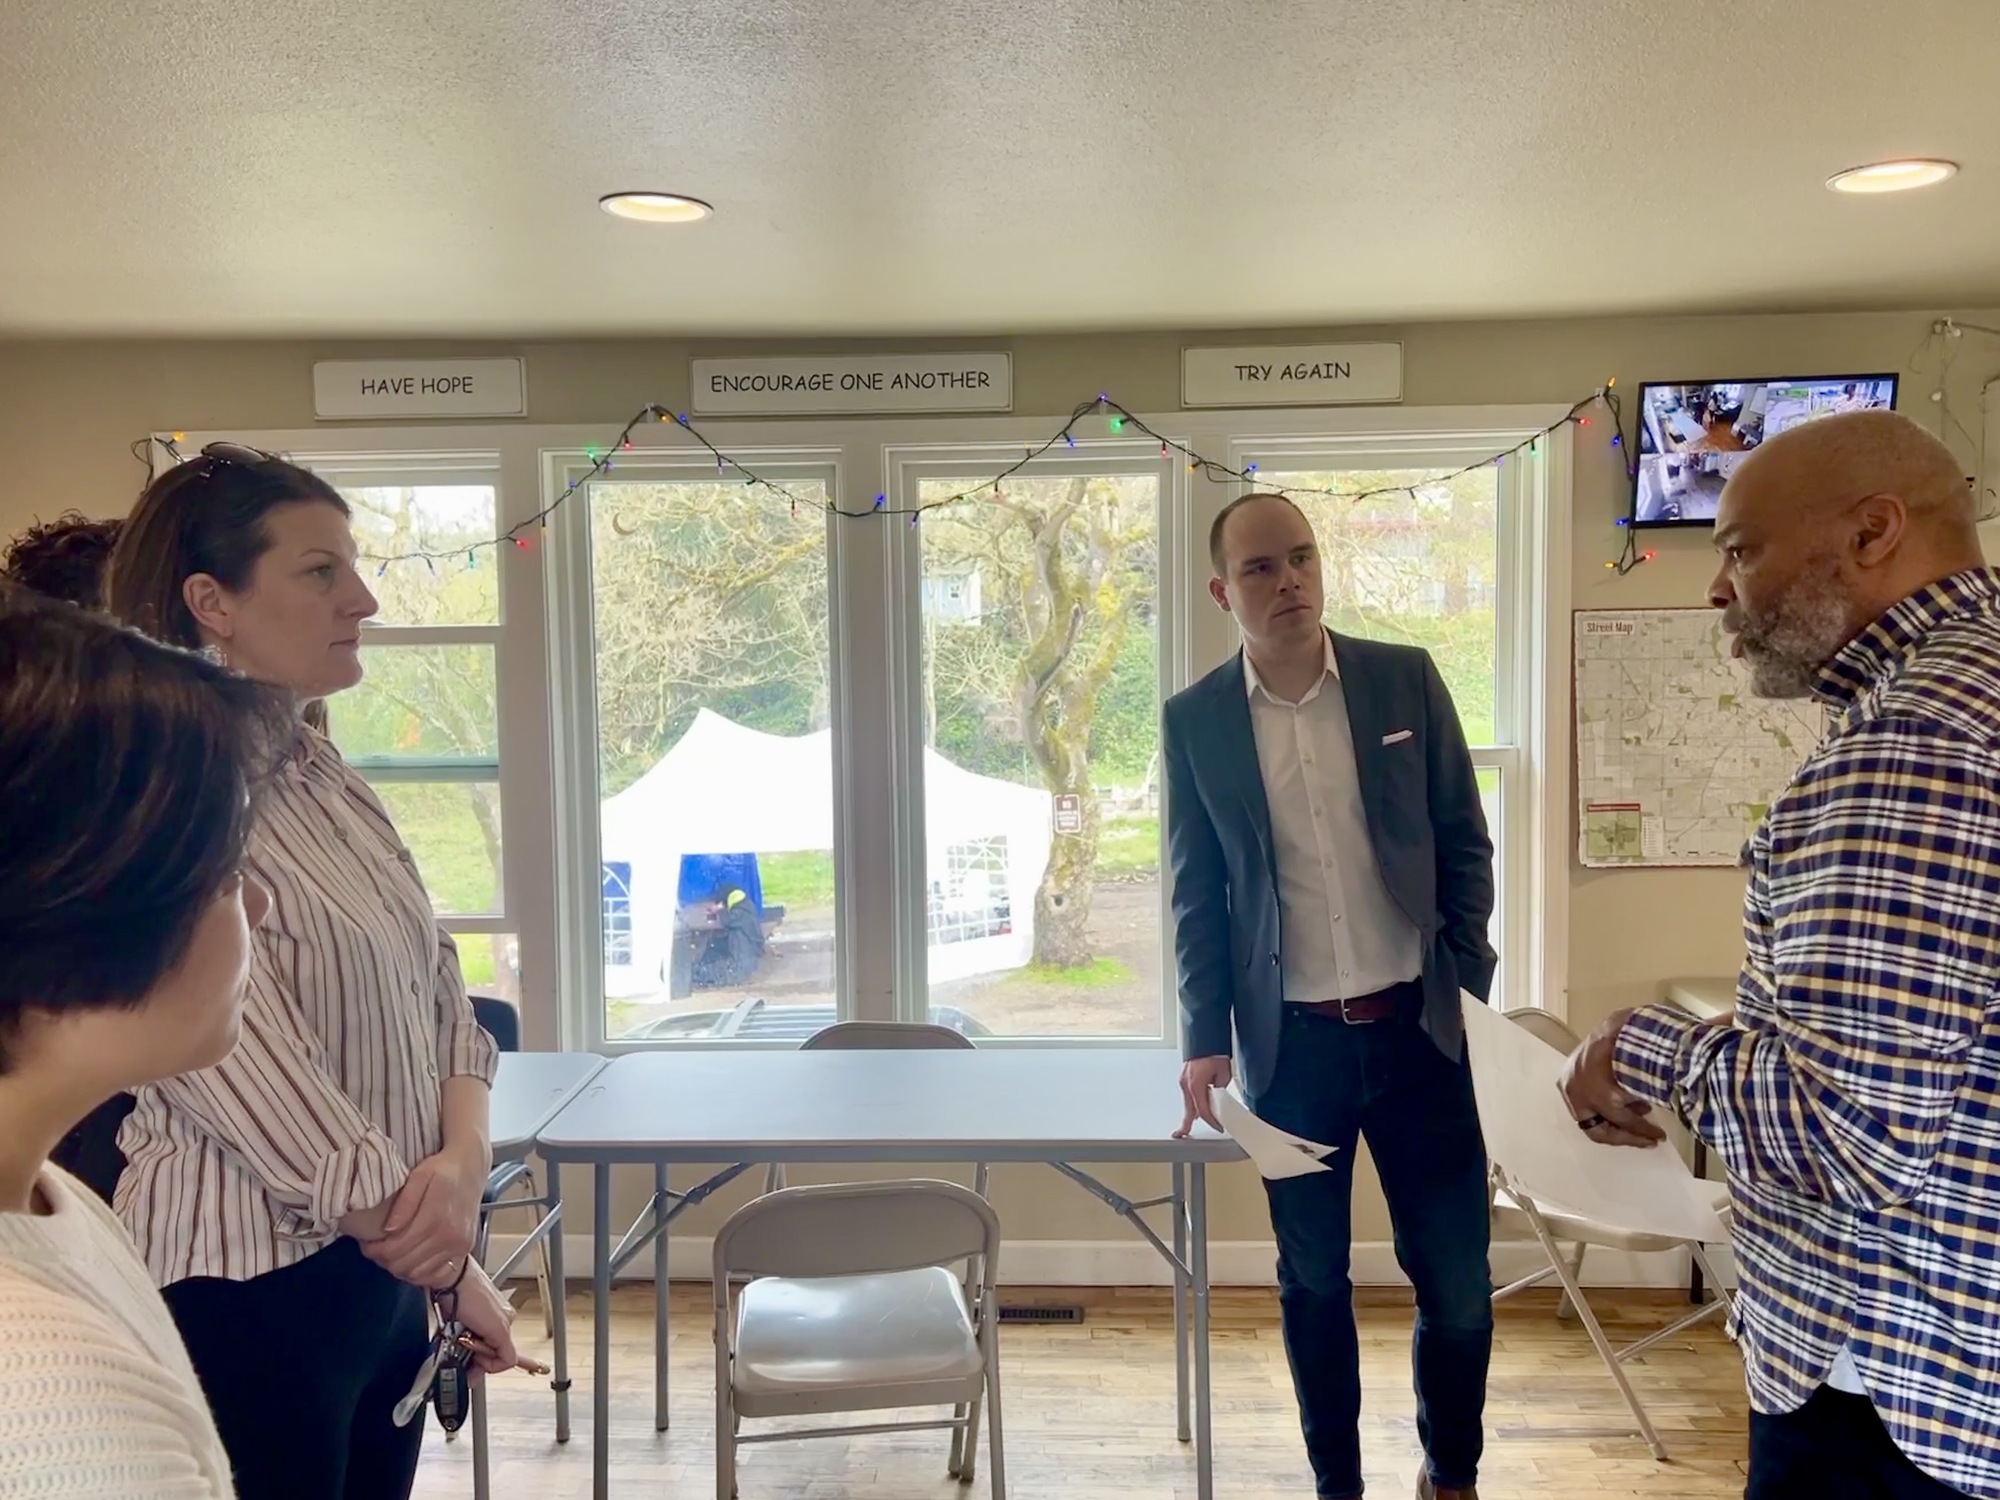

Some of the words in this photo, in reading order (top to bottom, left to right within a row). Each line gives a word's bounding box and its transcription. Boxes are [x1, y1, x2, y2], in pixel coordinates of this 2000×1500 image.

[711, 373, 834, 393] ENCOURAGE
[840, 372, 884, 391] ONE
[890, 370, 990, 390] ANOTHER
[1234, 364, 1273, 382] TRY
[1280, 361, 1351, 381] AGAIN
[361, 377, 415, 395] HAVE
[421, 376, 473, 394] HOPE
[1586, 622, 1613, 633] Street
[1615, 622, 1633, 636] Map
